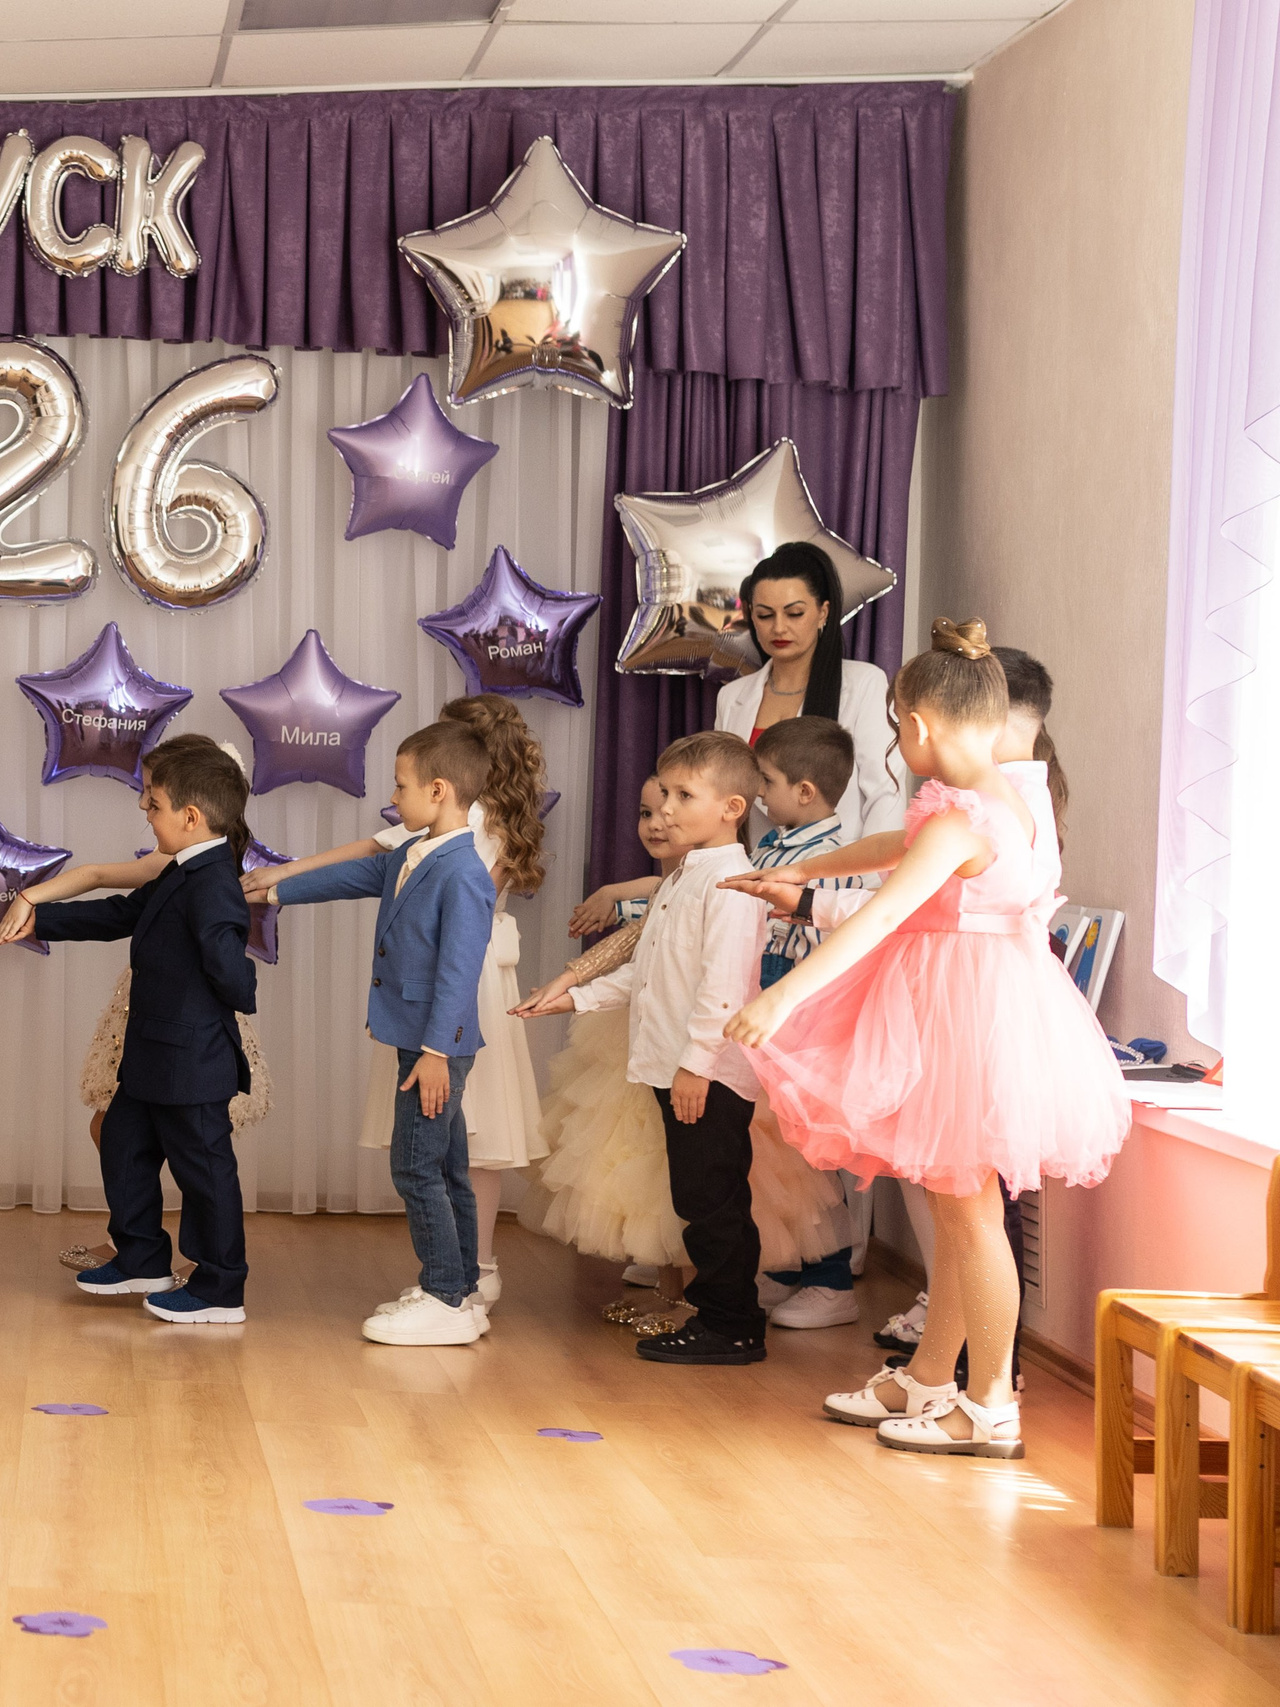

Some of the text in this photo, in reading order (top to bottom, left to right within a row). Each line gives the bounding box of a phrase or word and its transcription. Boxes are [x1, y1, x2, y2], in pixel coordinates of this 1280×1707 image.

[487, 641, 544, 660] Роман
[61, 708, 147, 731] Стефания
[280, 725, 341, 746] Мила
